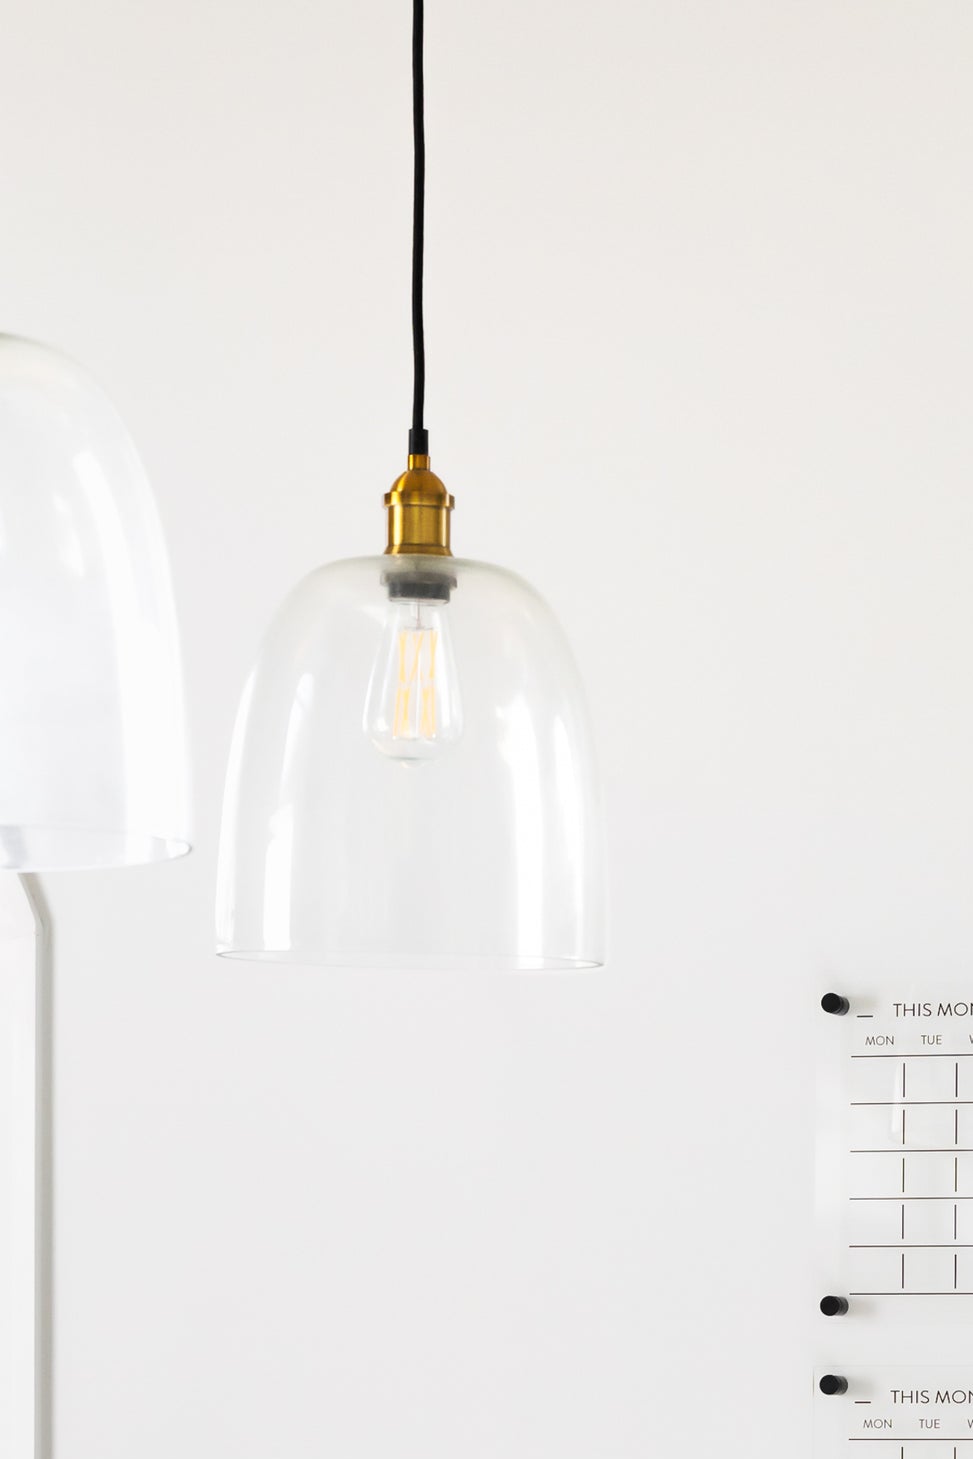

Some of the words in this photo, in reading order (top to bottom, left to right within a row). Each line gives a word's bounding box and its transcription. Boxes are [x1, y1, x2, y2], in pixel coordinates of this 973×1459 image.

[892, 1002, 933, 1018] THIS
[864, 1035, 895, 1046] MON
[920, 1034, 943, 1046] TUE
[889, 1389, 930, 1405] THIS
[862, 1418, 893, 1430] MON
[918, 1418, 941, 1429] TUE
